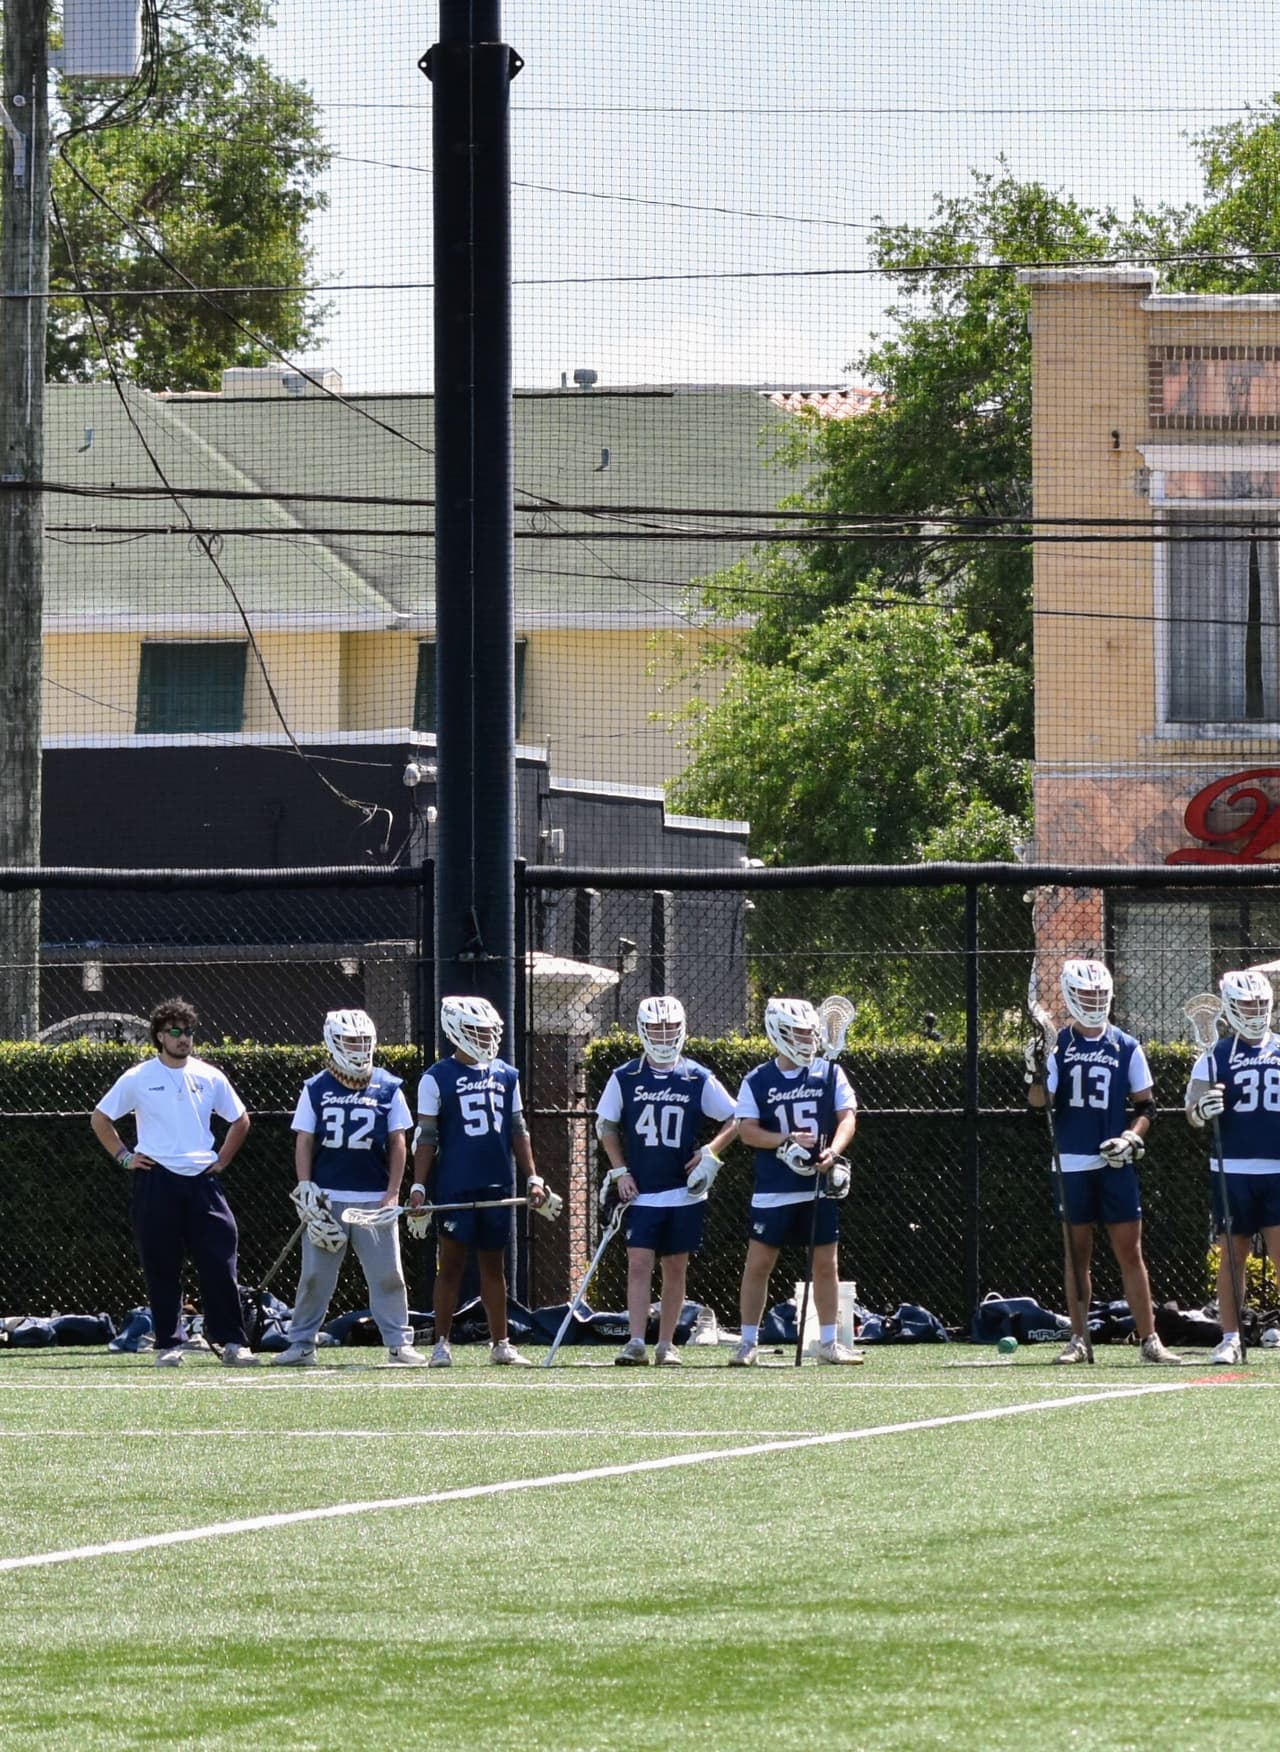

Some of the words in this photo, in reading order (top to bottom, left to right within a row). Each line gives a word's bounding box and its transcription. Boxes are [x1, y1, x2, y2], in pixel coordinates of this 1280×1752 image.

[1064, 1046, 1120, 1068] Southern
[320, 1091, 379, 1107] Southern
[456, 1076, 506, 1094] Southern
[633, 1085, 691, 1103] Southern
[767, 1085, 824, 1104] Southern
[1069, 1064, 1112, 1110] 13
[322, 1107, 376, 1151] 32
[459, 1093, 505, 1138] 55
[635, 1104, 685, 1149] 40
[774, 1100, 819, 1143] 15
